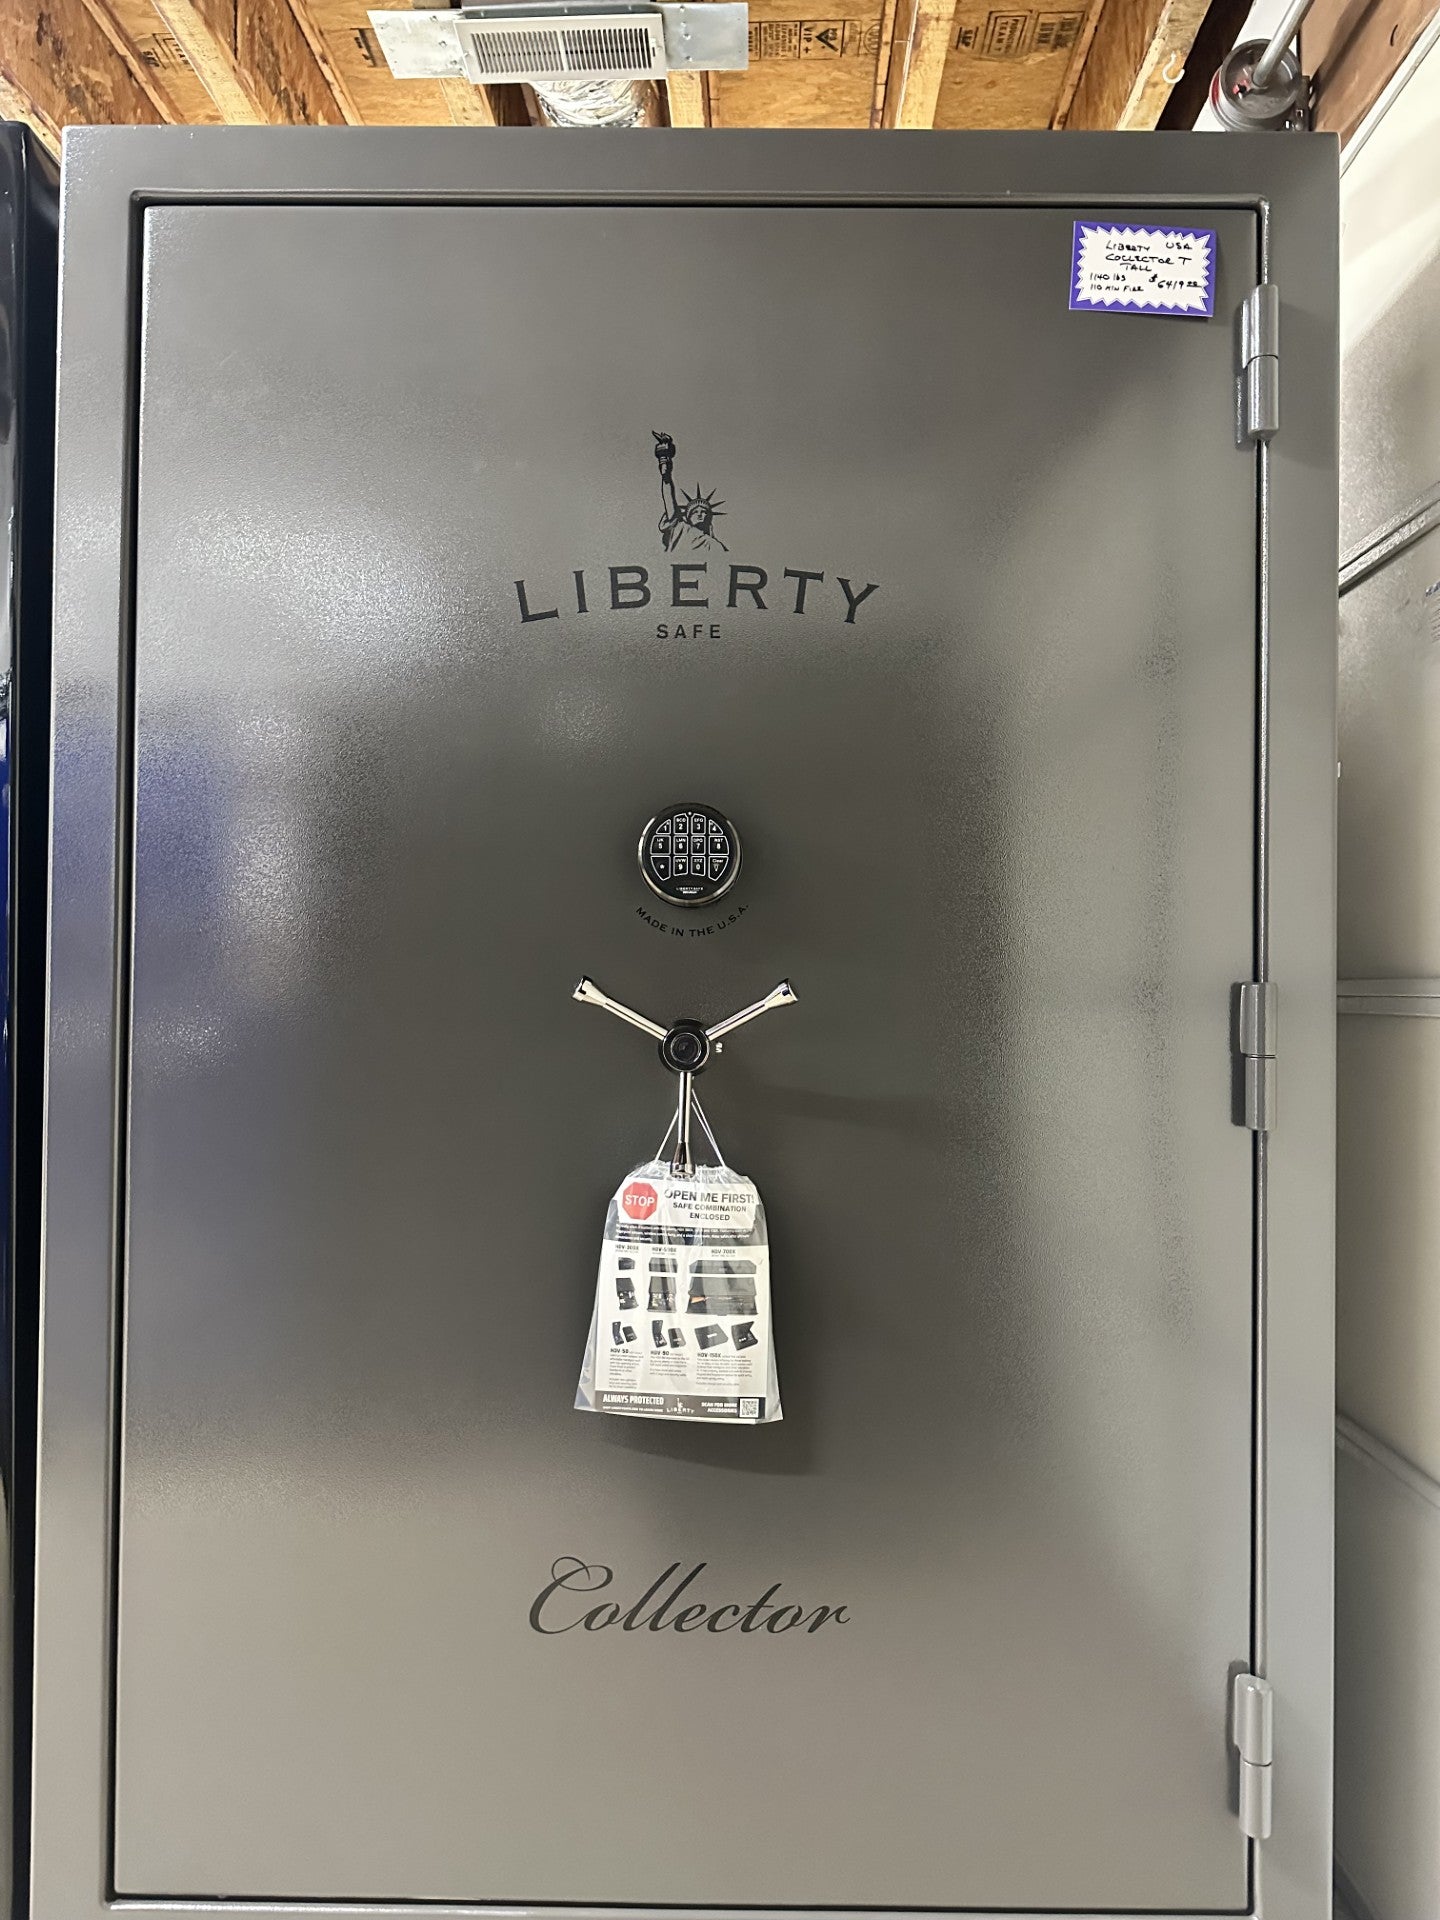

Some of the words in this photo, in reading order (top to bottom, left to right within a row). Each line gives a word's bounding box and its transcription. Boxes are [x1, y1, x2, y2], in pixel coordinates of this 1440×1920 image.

[803, 26, 813, 43] VIP
[1165, 242, 1194, 250] USA
[1119, 262, 1152, 272] TALL
[1178, 256, 1192, 266] T
[1090, 272, 1110, 281] 1140
[514, 562, 880, 624] LIBERTY
[656, 624, 722, 639] SAFE
[636, 906, 668, 932] MADE
[671, 927, 684, 937] IN
[689, 926, 715, 937] THE
[718, 904, 749, 930] U.S.A.
[625, 1194, 655, 1207] STOP
[664, 1188, 697, 1202] OPEN
[700, 1192, 718, 1203] ME
[721, 1193, 755, 1204] FIRST!
[694, 1204, 747, 1212] COMBINATION
[690, 1212, 730, 1220] ENCLOSED
[603, 1394, 629, 1403] ALWAYS
[630, 1396, 664, 1405] PROTECTED
[529, 1556, 851, 1634] Collector
